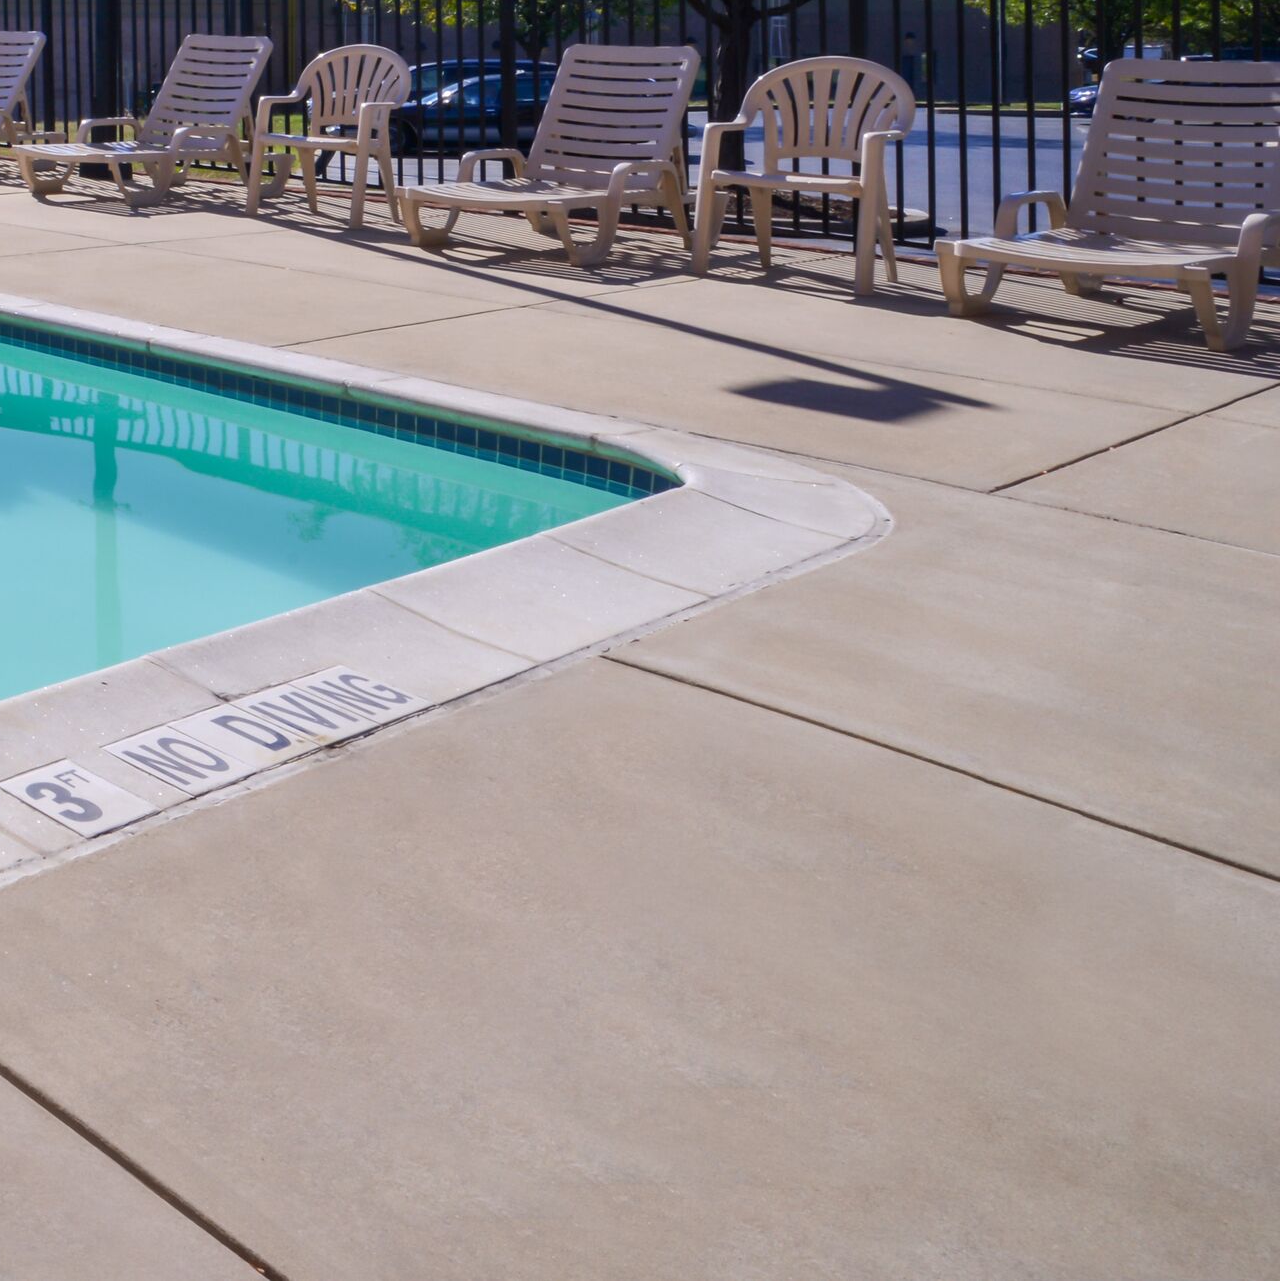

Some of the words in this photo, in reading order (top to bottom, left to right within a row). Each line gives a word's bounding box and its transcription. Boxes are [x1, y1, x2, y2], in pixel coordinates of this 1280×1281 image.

[121, 737, 230, 786] NO
[210, 673, 413, 752] DIVING
[53, 769, 91, 789] FT
[25, 781, 104, 823] 3
